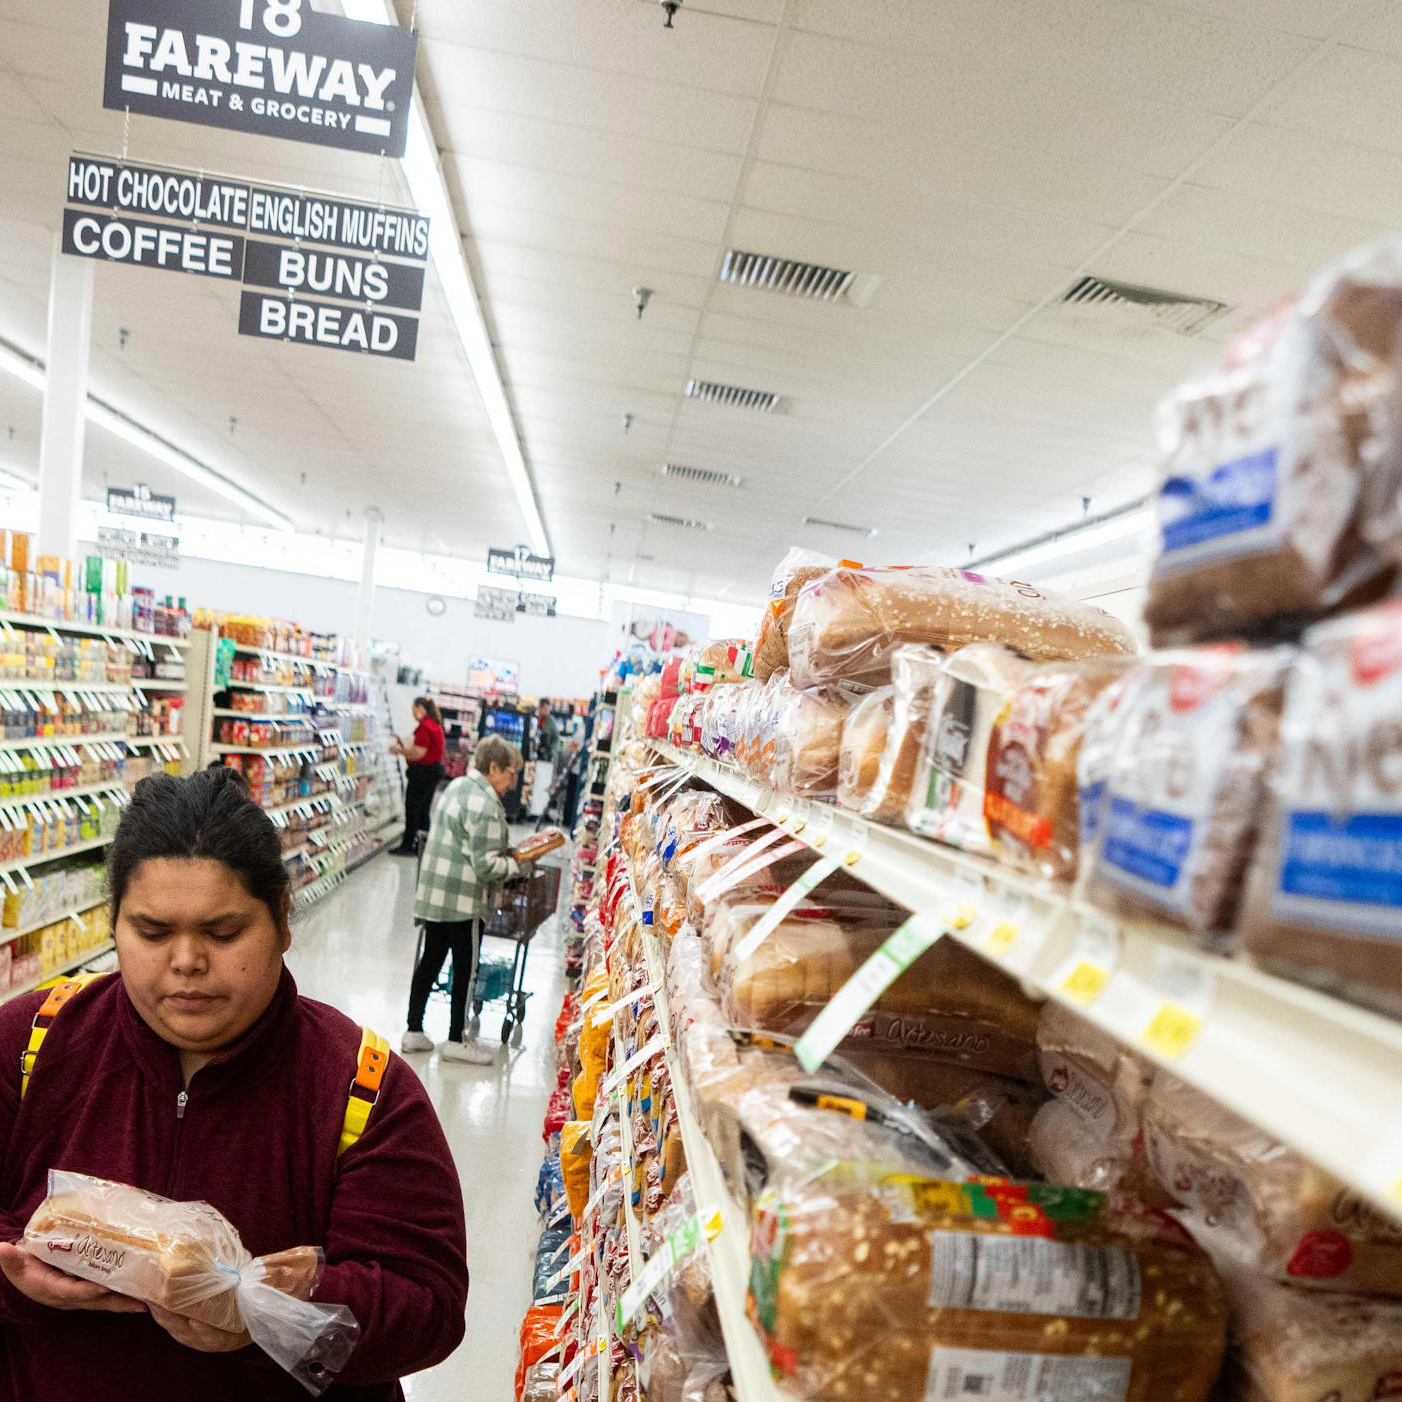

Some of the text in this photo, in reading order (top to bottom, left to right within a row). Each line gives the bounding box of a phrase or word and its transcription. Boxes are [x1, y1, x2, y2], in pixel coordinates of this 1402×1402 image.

[121, 21, 396, 111] FAREWAY
[162, 80, 351, 130] MEAT & GROCERY
[69, 162, 247, 225] HOT CHOCOLATE
[72, 218, 234, 276] COFFEE
[250, 199, 428, 256] ENGLISH MUFFINS
[279, 250, 389, 300] BUNS
[259, 299, 399, 352] BREAD
